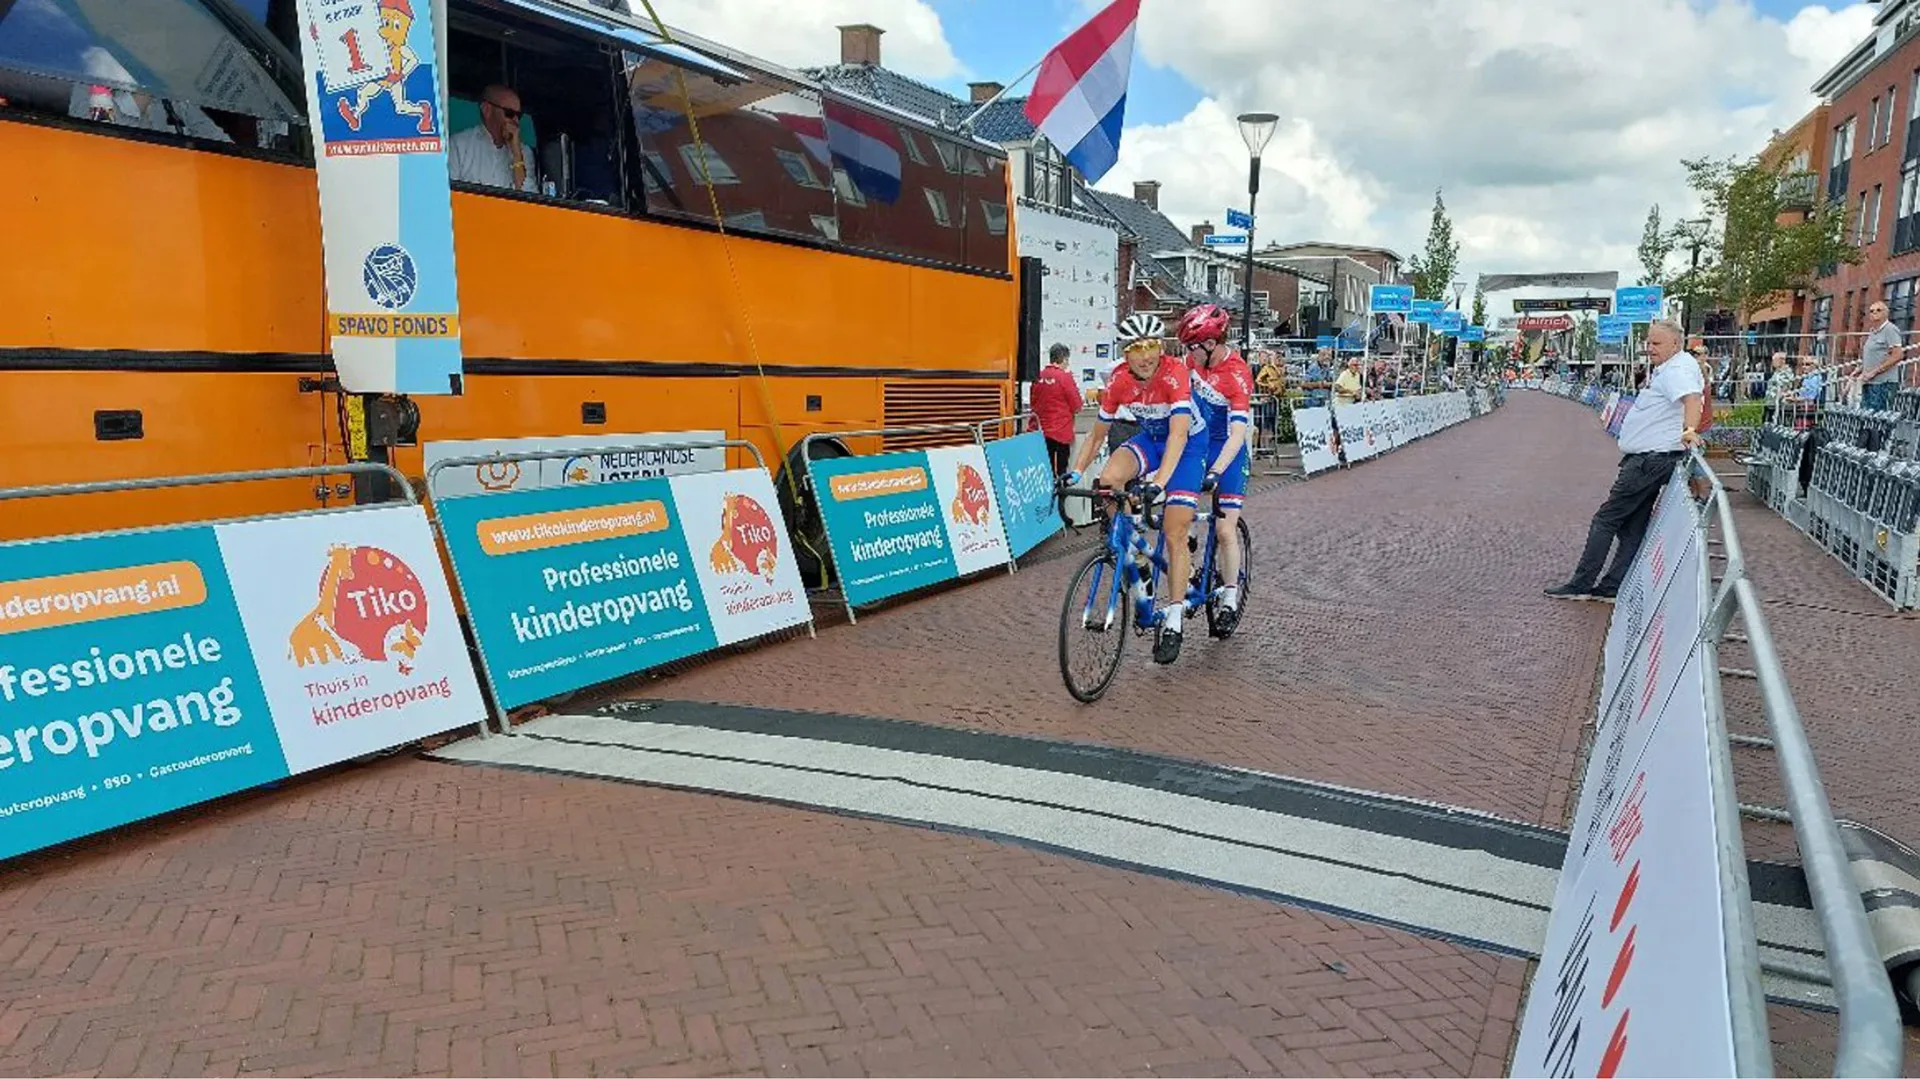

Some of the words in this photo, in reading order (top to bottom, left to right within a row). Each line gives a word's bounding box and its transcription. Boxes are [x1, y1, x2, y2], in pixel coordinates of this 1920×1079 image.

[338, 317, 388, 335] SPAVO
[393, 316, 448, 335] FONDS
[601, 448, 695, 469] NEDERLANDSE
[491, 509, 656, 544] www.tikokinderopvang.nl
[736, 523, 770, 545] Tiko
[543, 548, 679, 592] Professionele
[347, 585, 416, 618] Tiko
[511, 578, 693, 643] kinderopvang
[304, 677, 350, 698] Thuis
[353, 673, 368, 687] in
[312, 677, 451, 726] kinderopvang
[150, 742, 254, 778] Gastouderopvang
